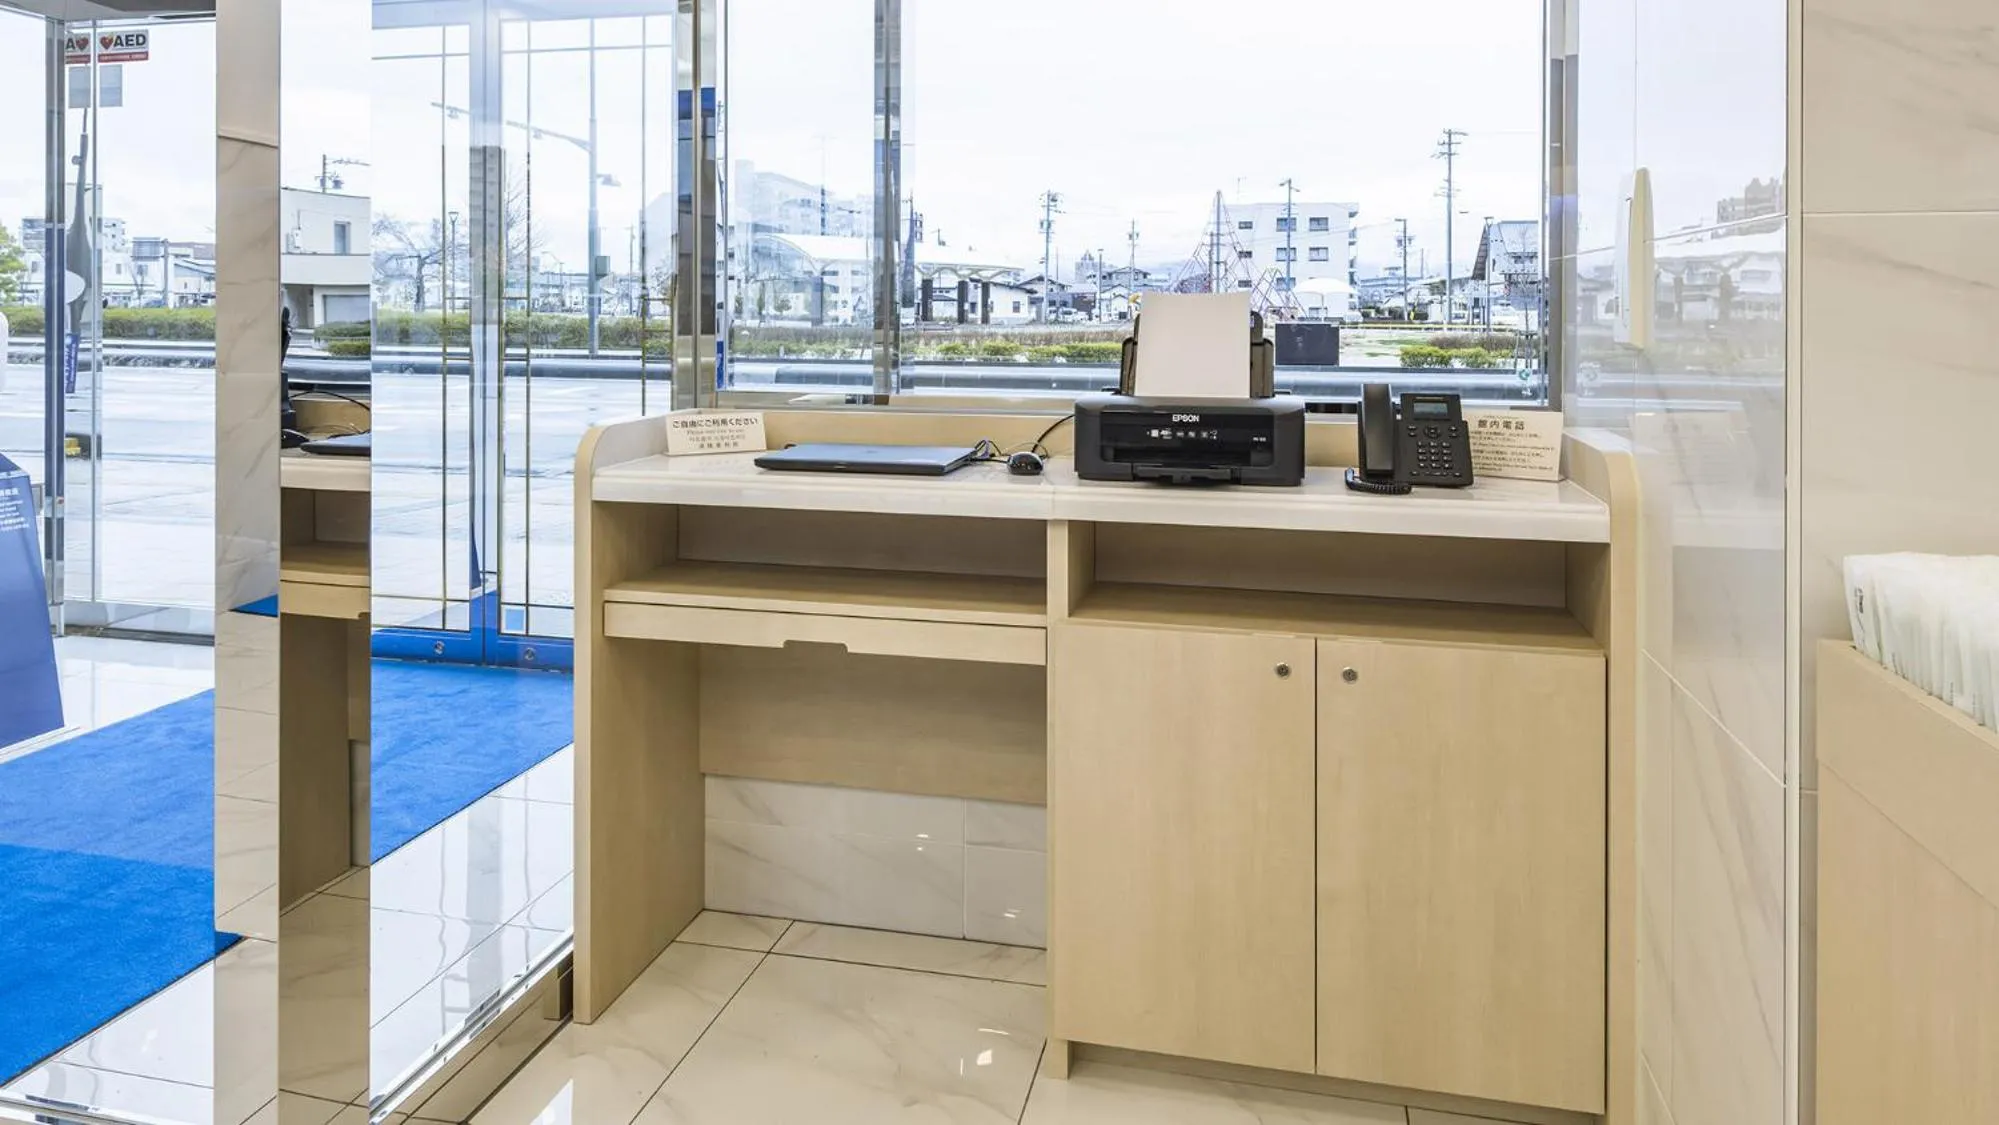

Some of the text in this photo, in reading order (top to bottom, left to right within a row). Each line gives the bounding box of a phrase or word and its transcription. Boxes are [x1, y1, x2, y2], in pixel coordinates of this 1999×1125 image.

[113, 33, 146, 47] AED
[672, 418, 758, 428] ご自由にご利用ください
[1172, 414, 1200, 422] EPSON
[1478, 419, 1525, 431] 館内電話
